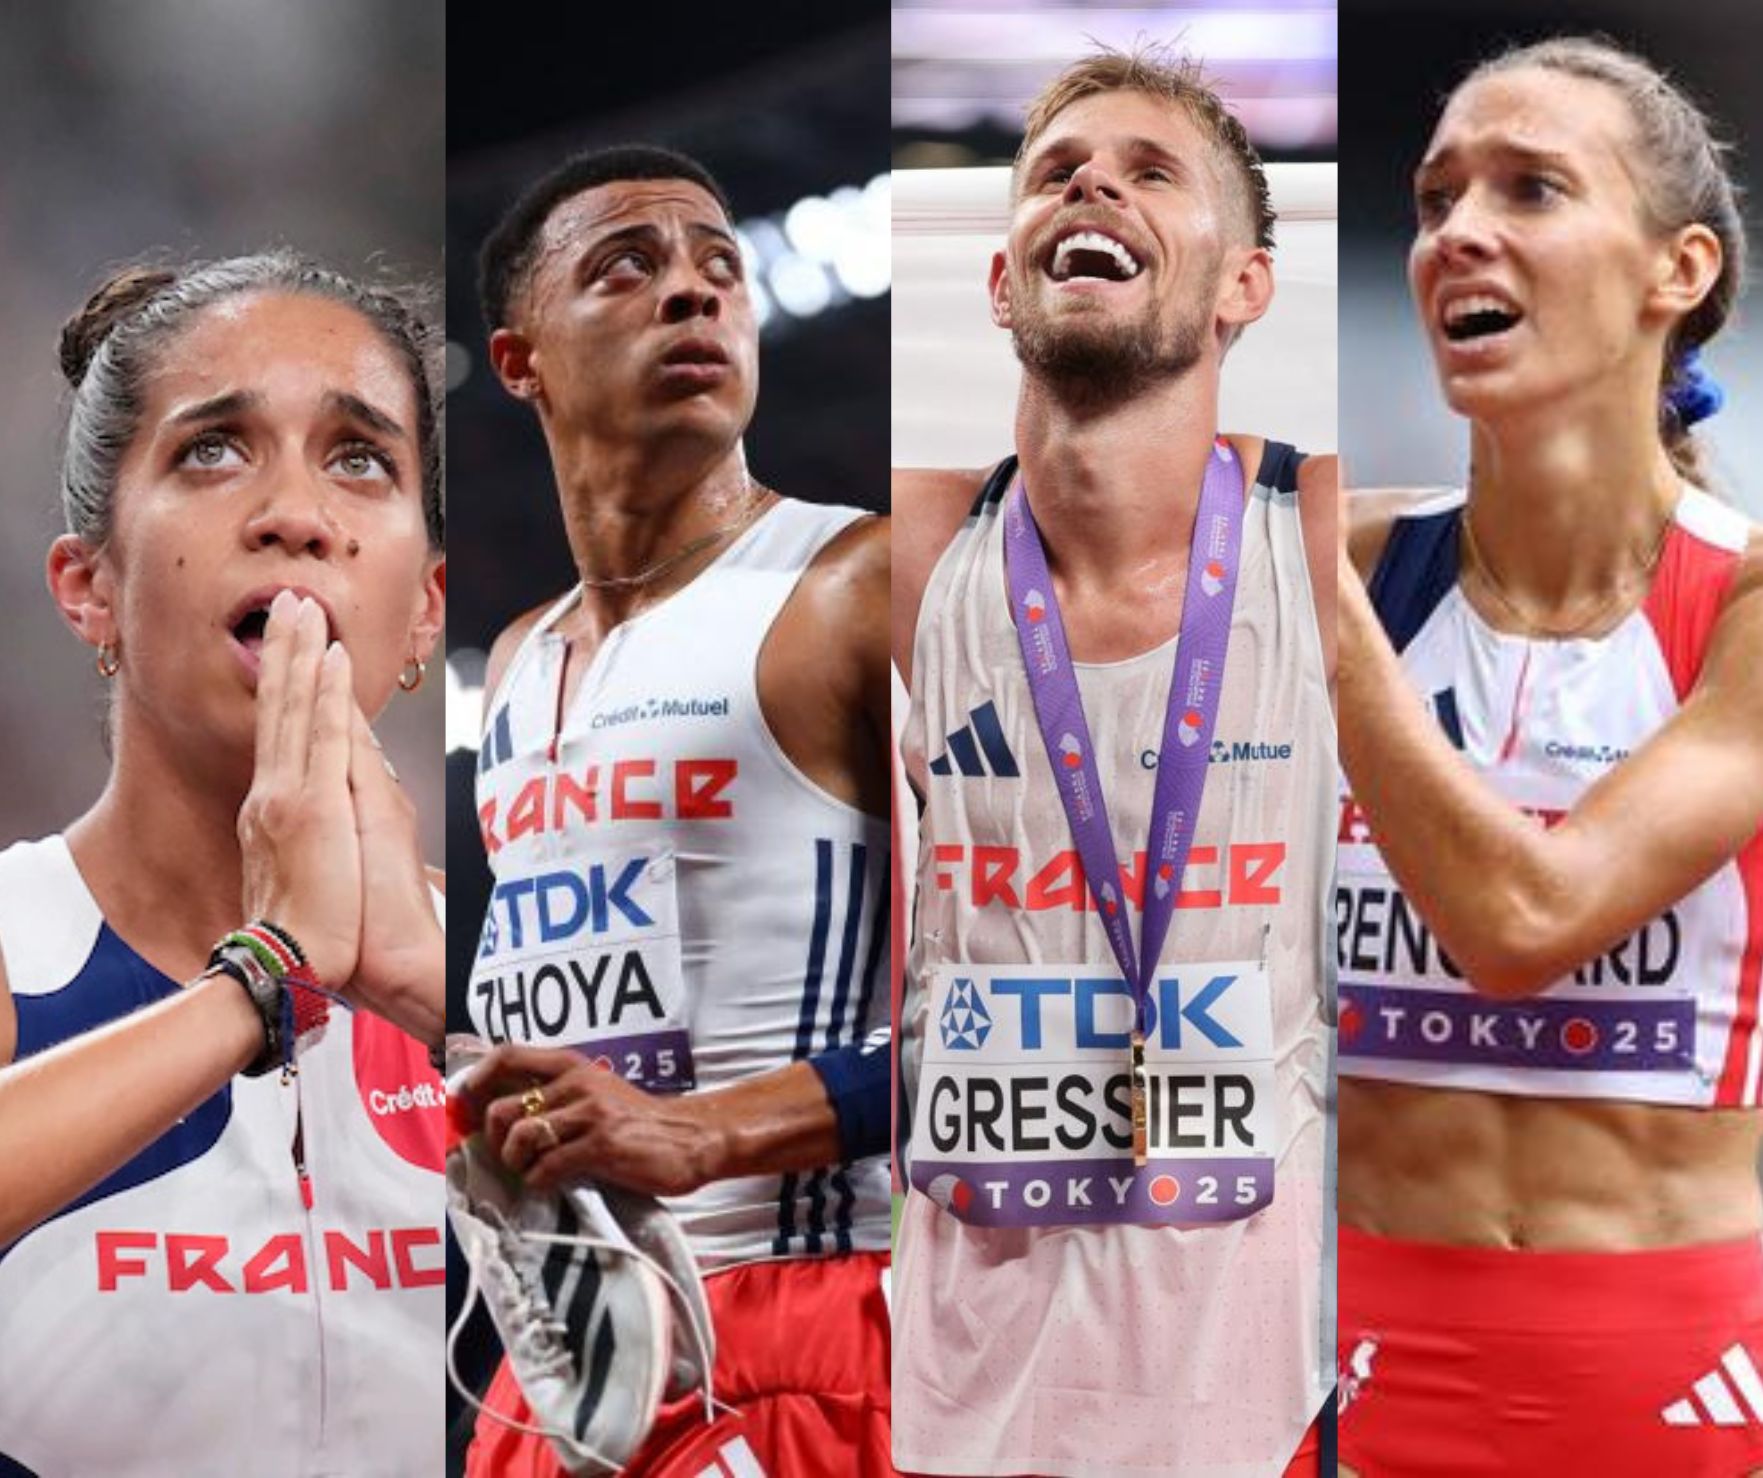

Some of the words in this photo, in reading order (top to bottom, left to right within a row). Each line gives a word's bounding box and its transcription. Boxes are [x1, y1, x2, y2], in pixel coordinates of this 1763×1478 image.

[661, 697, 728, 717] Mutuel
[495, 856, 655, 949] TDK
[477, 949, 666, 1045] ZHOYA
[990, 975, 1245, 1050] TDK
[1612, 1020, 1678, 1054] 25
[929, 1074, 1256, 1153] GRESSIER
[1194, 1176, 1258, 1205] 25
[95, 1227, 446, 1294] FRANC
